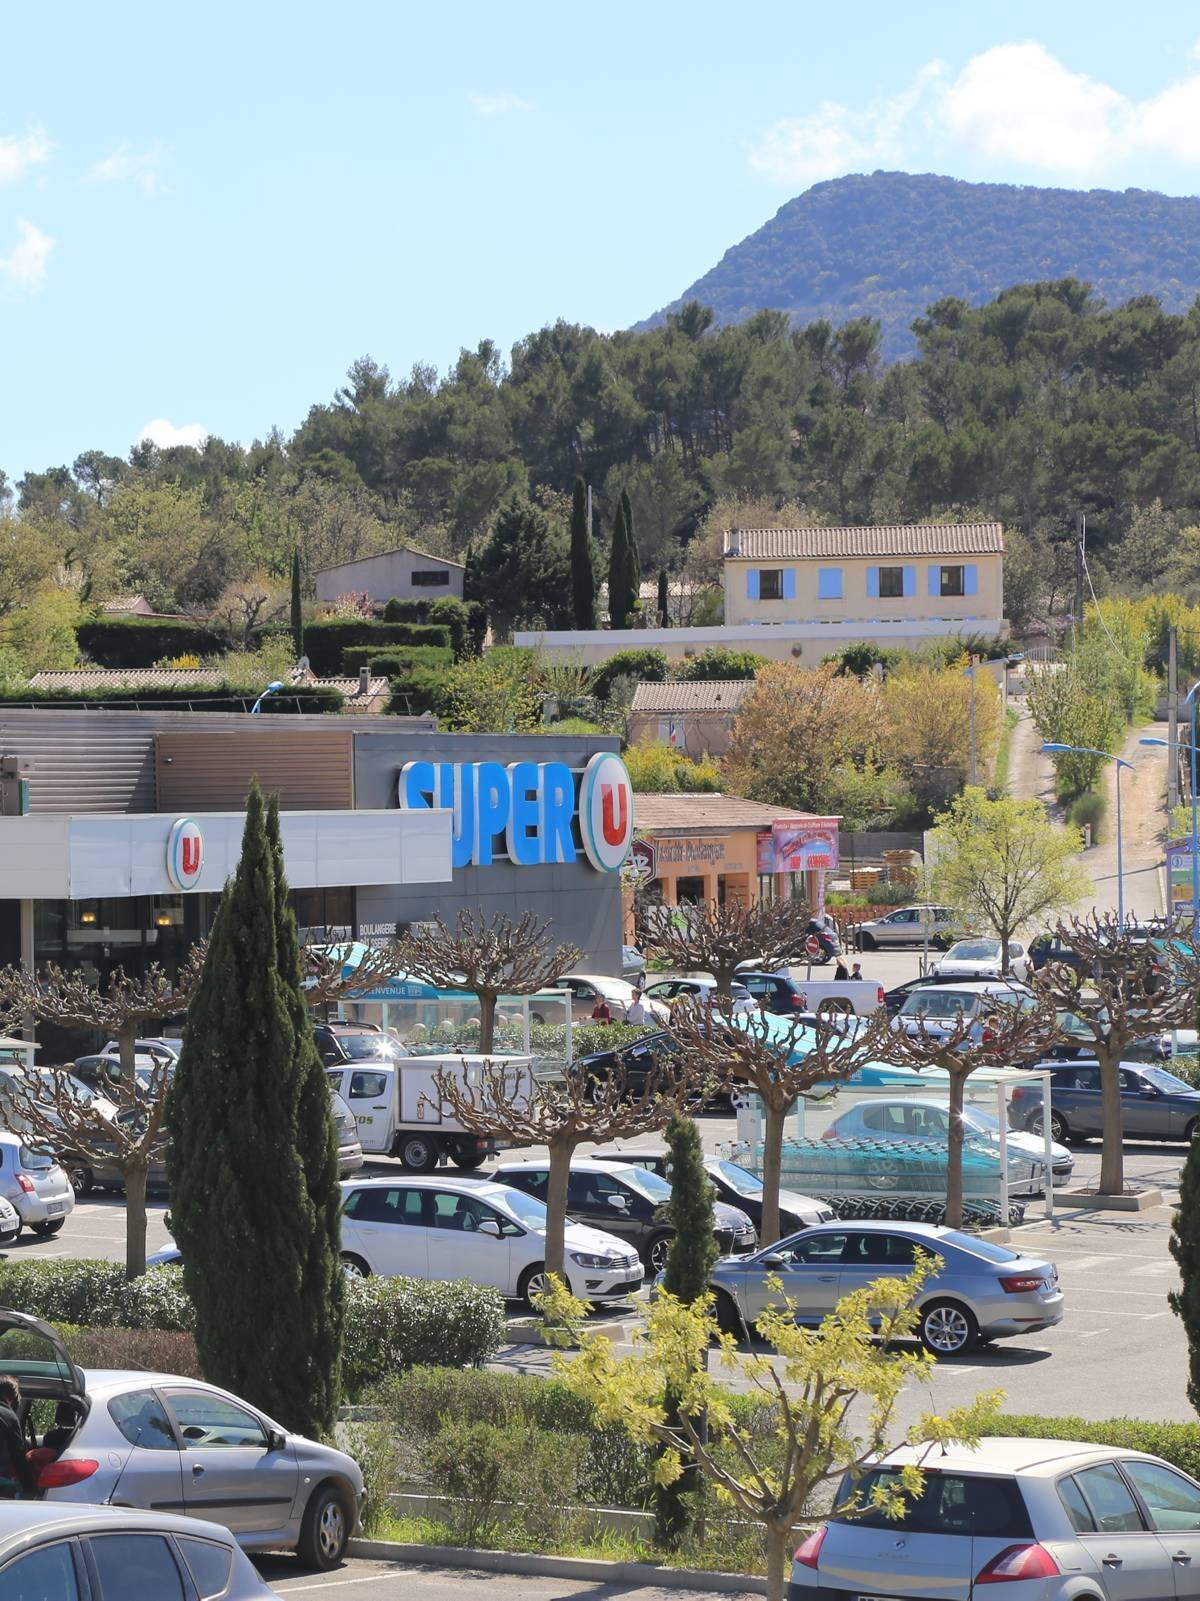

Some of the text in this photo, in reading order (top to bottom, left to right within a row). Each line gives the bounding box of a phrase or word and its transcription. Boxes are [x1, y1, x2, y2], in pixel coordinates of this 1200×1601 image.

[601, 784, 627, 847] U
[183, 836, 200, 875] U
[360, 922, 396, 936] BOULANGERIE
